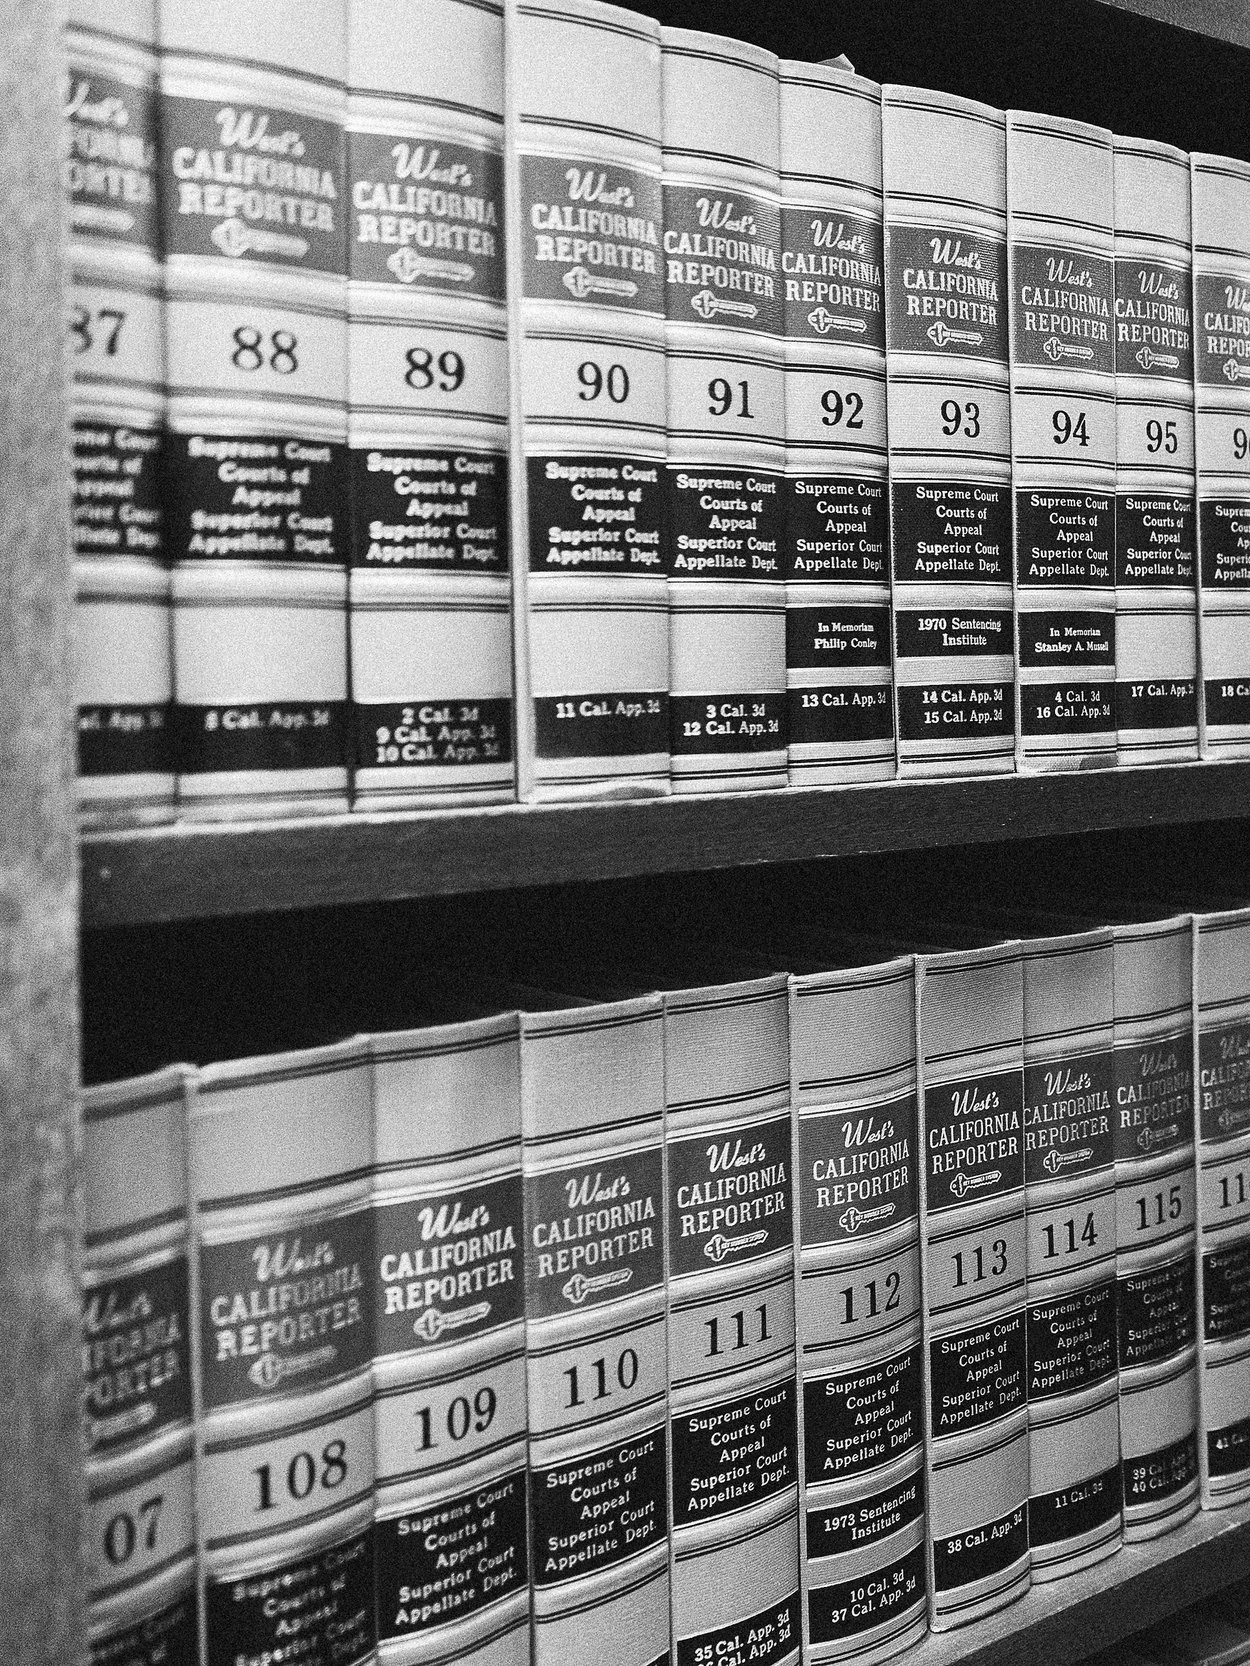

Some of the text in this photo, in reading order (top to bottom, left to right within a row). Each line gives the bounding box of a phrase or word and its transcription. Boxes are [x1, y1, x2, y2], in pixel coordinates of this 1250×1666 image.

[352, 181, 496, 226] CALIFORNIA
[566, 168, 634, 208] West's
[531, 204, 657, 245] CALIFORNIA
[696, 198, 757, 235] West's
[357, 214, 495, 257] REPORTER
[663, 231, 780, 271] CALIFORNIA
[811, 220, 866, 253] West's
[535, 234, 656, 274] REPORTER
[782, 252, 882, 287] CALIFORNIA
[930, 237, 982, 270] West's
[667, 260, 776, 298] REPORTER
[903, 268, 998, 301] CALIFORNIA
[1046, 257, 1094, 287] West's
[1138, 271, 1180, 300] West's
[785, 279, 881, 312] REPORTER
[906, 295, 998, 326] REPORTER
[1021, 286, 1110, 318] CALIFORNIA
[1116, 298, 1190, 327] CALIFORNIA
[1025, 312, 1108, 341] REPORTER
[1118, 324, 1190, 350] REPORTER
[232, 325, 298, 375] 88
[404, 347, 466, 392] 89
[577, 362, 629, 403] 90
[708, 378, 754, 418] 91
[821, 390, 863, 429] 92
[941, 400, 980, 438] 93
[1052, 410, 1090, 446] 94
[1146, 420, 1178, 453] 95
[916, 486, 999, 503] Supreme Court
[936, 505, 987, 519] Courts of
[1030, 495, 1108, 511] Supreme Court
[944, 523, 982, 536] Appeal
[1049, 514, 1098, 527] Courts of
[1057, 531, 1093, 543] Appeal
[915, 559, 1001, 573] Appellate Dept.
[917, 542, 1000, 557] Superior Court
[1032, 548, 1108, 561] Superior Court
[1029, 564, 1109, 578] Appellate Dept.
[818, 622, 829, 632] In
[918, 618, 1002, 632] 1970 Sentencing
[942, 634, 987, 646] Institute
[1050, 628, 1060, 637] In
[814, 638, 878, 651] Philip Conley
[1034, 643, 1072, 653] Stanley
[802, 695, 819, 708] 13
[822, 694, 849, 706] Cal.
[852, 693, 877, 706] App.
[923, 689, 1002, 703] 14 Cal. App. 3d
[1055, 691, 1100, 703] 4 Cal. 3d
[1131, 686, 1143, 697] 17
[1148, 685, 1168, 696] Cal.
[924, 709, 1002, 723] 15 Cal. App. 3d
[1036, 704, 1110, 718] 16 Cal. App. 3d
[1044, 1068, 1091, 1096] West's
[951, 1087, 999, 1117] West's
[1024, 1091, 1111, 1126] CALIFORNIA
[842, 1117, 895, 1149] West's
[929, 1111, 1020, 1149] CALIFORNIA
[1026, 1116, 1110, 1151] REPORTER
[706, 1139, 765, 1173] West's
[812, 1139, 910, 1181] CALIFORNIA
[932, 1137, 1019, 1175] REPORTER
[565, 1172, 631, 1208] West's
[677, 1163, 787, 1209] CALIFORNIA
[816, 1166, 909, 1208] REPORTER
[417, 1202, 490, 1241] West's
[532, 1196, 656, 1248] CALIFORNIA
[680, 1191, 786, 1238] REPORTER
[1136, 1185, 1182, 1231] 115
[1042, 1212, 1098, 1259] 114
[380, 1225, 517, 1282] CALIFORNIA
[537, 1227, 655, 1280] REPORTER
[951, 1239, 1007, 1288] 113
[384, 1258, 515, 1315] REPORTER
[839, 1271, 901, 1325] 112
[704, 1304, 773, 1358] 111
[564, 1349, 639, 1409] 110
[825, 1356, 911, 1396] Supreme Court
[846, 1380, 900, 1409] Courts of
[415, 1387, 497, 1453] 109
[826, 1411, 912, 1452] Superior Court
[854, 1403, 895, 1425] Appeal
[823, 1429, 914, 1470] Appellate Dept.
[252, 1439, 348, 1511] 108
[824, 1485, 917, 1532] 1973 Sentencing
[851, 1511, 901, 1541] Institute
[947, 1510, 1023, 1554] 38 Cal. App. 3d
[831, 1576, 916, 1624] 37 Cal. App. 3d
[850, 1569, 905, 1602] 10 Cal. 3d
[694, 1610, 790, 1662] 35 Cal. App. 3d
